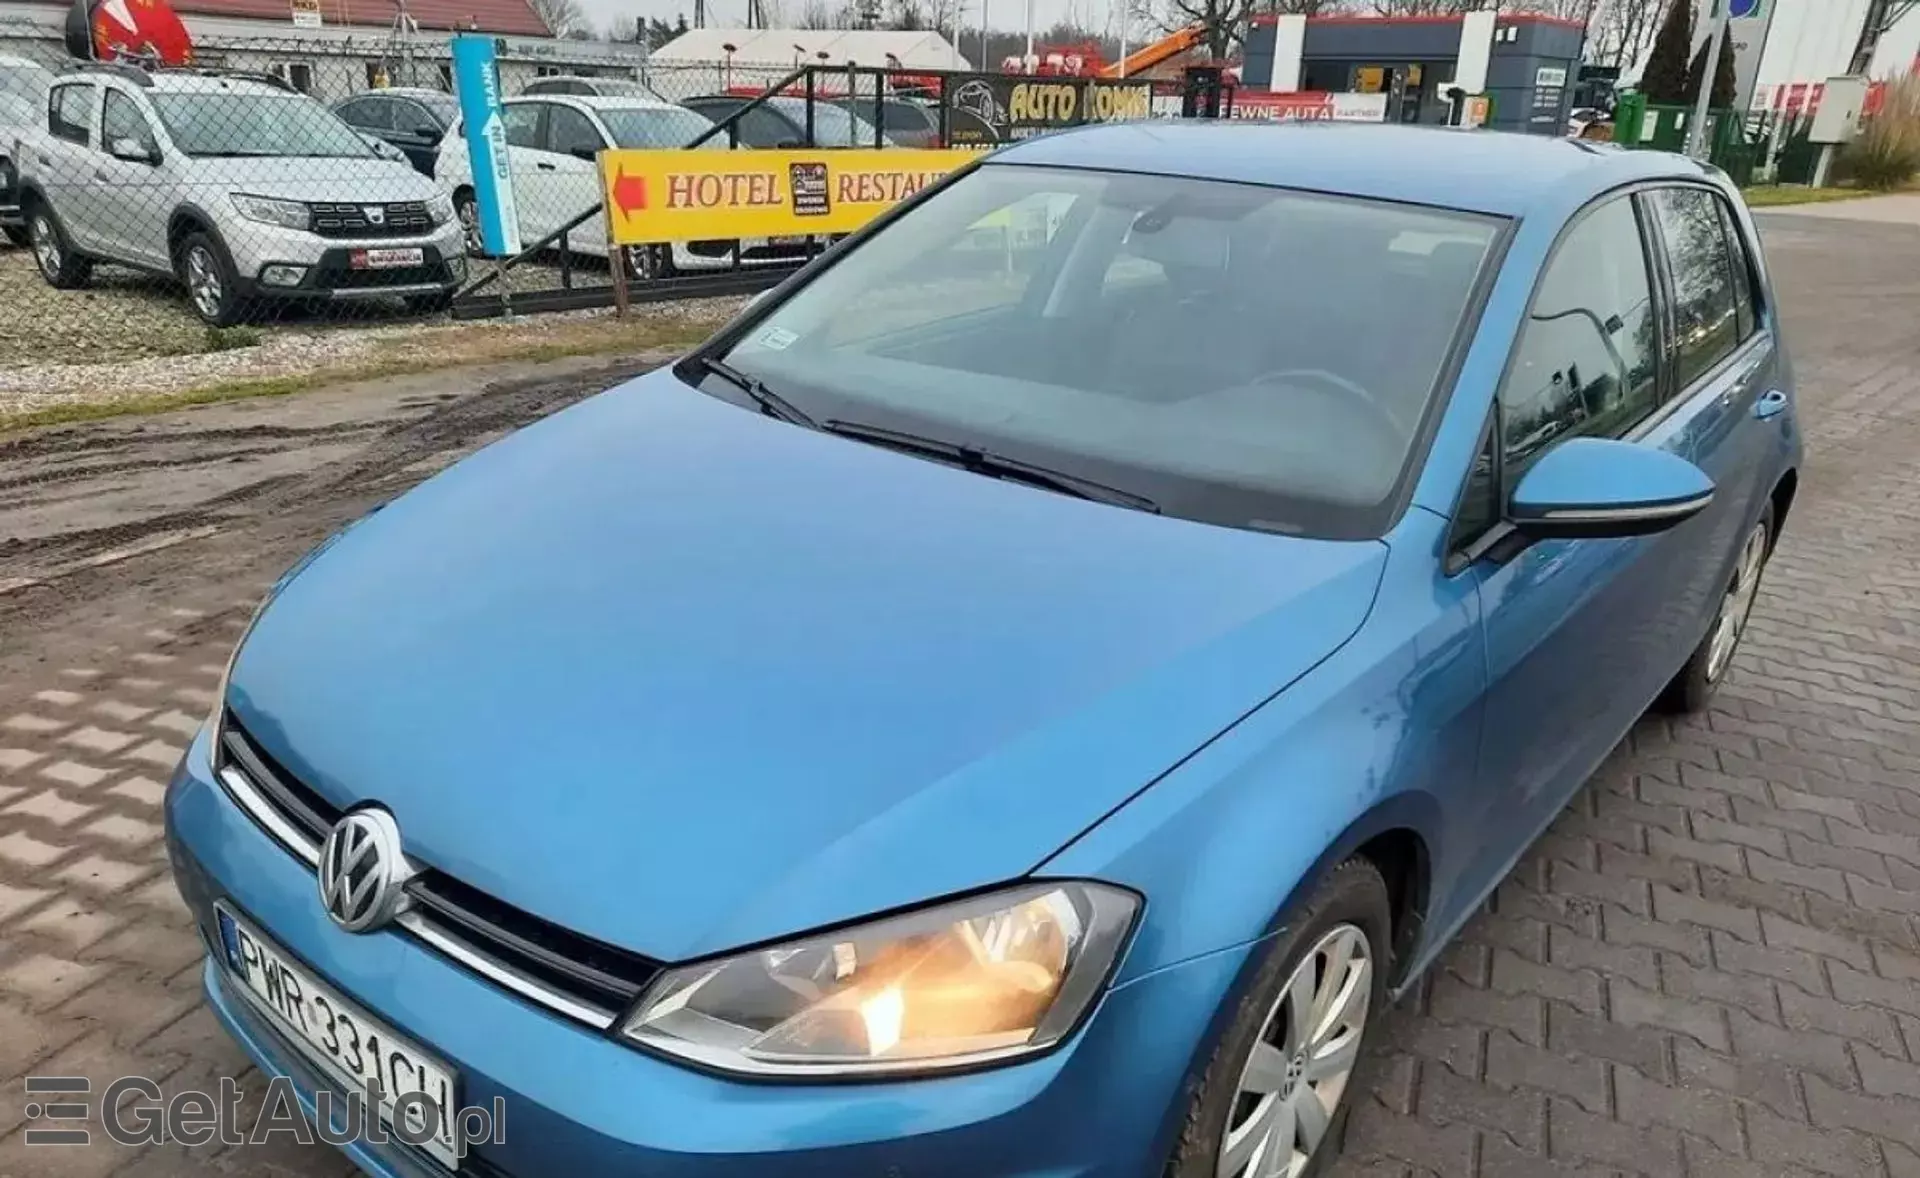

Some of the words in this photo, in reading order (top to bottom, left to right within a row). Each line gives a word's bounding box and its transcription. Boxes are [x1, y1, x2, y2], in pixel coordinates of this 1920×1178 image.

[480, 61, 497, 107] BANK
[1010, 83, 1076, 121] AUTO
[1284, 105, 1330, 120] AUTA
[665, 174, 782, 208] HOTEL
[837, 172, 948, 203] RESTAU
[238, 930, 309, 1033] PWR
